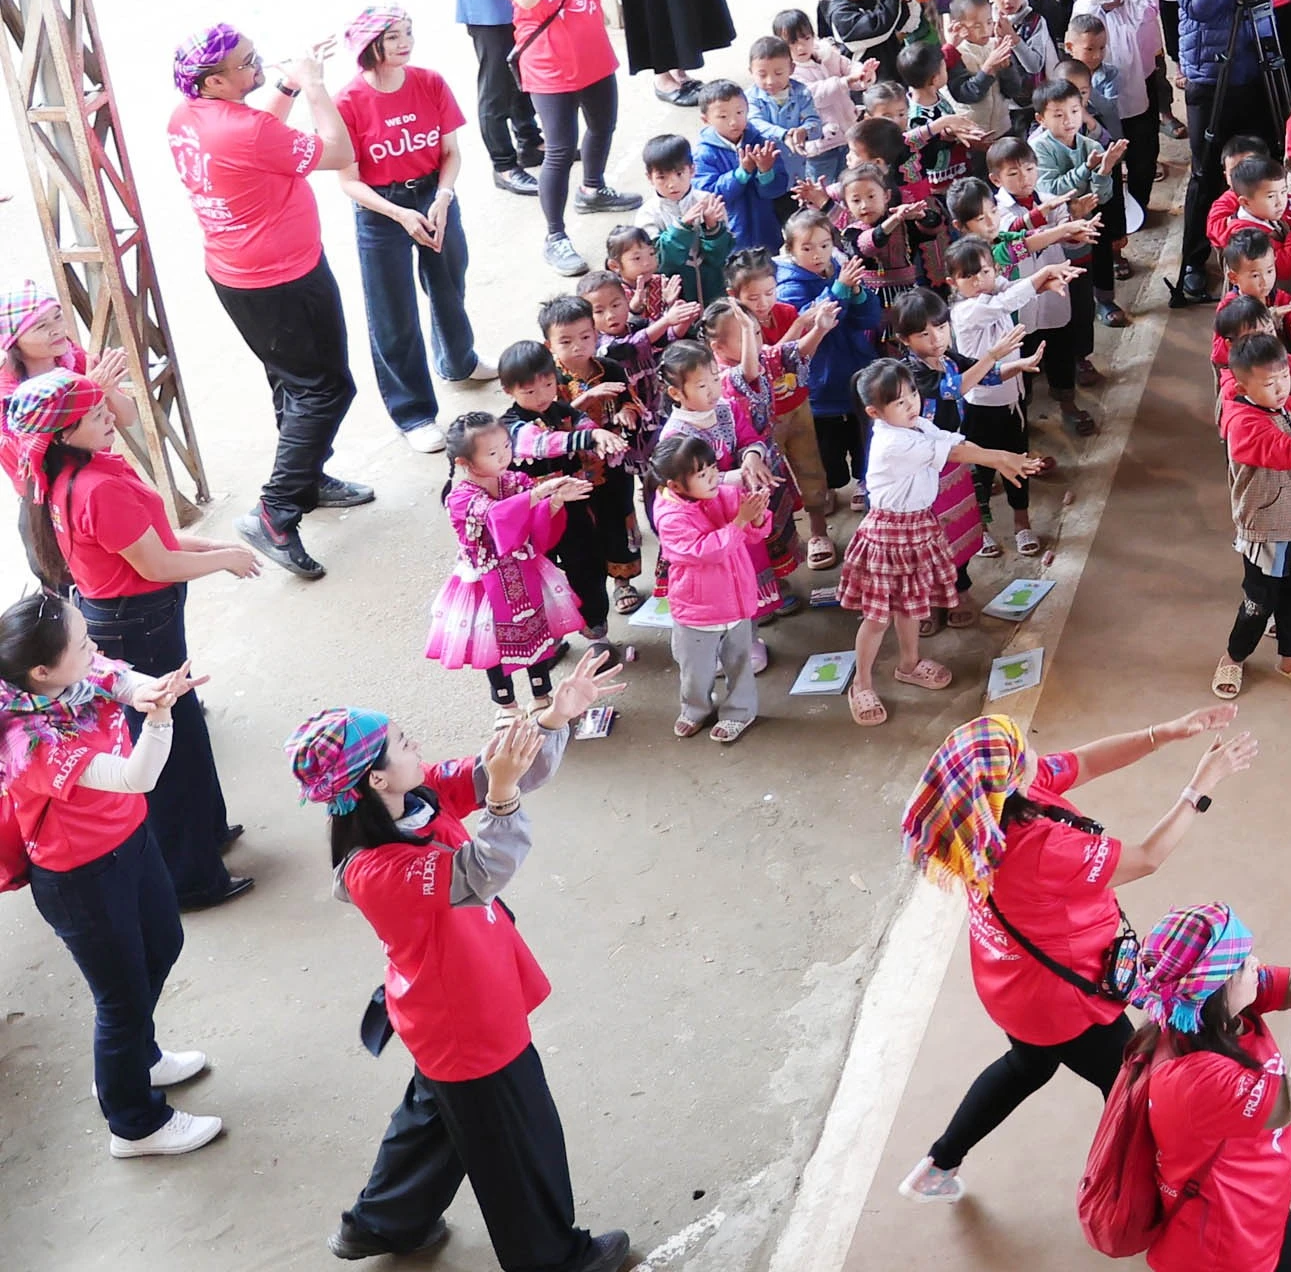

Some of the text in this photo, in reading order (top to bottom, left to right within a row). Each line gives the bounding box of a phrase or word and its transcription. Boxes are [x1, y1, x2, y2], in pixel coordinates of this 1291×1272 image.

[384, 113, 417, 128] WE DO
[368, 127, 441, 164] pulse
